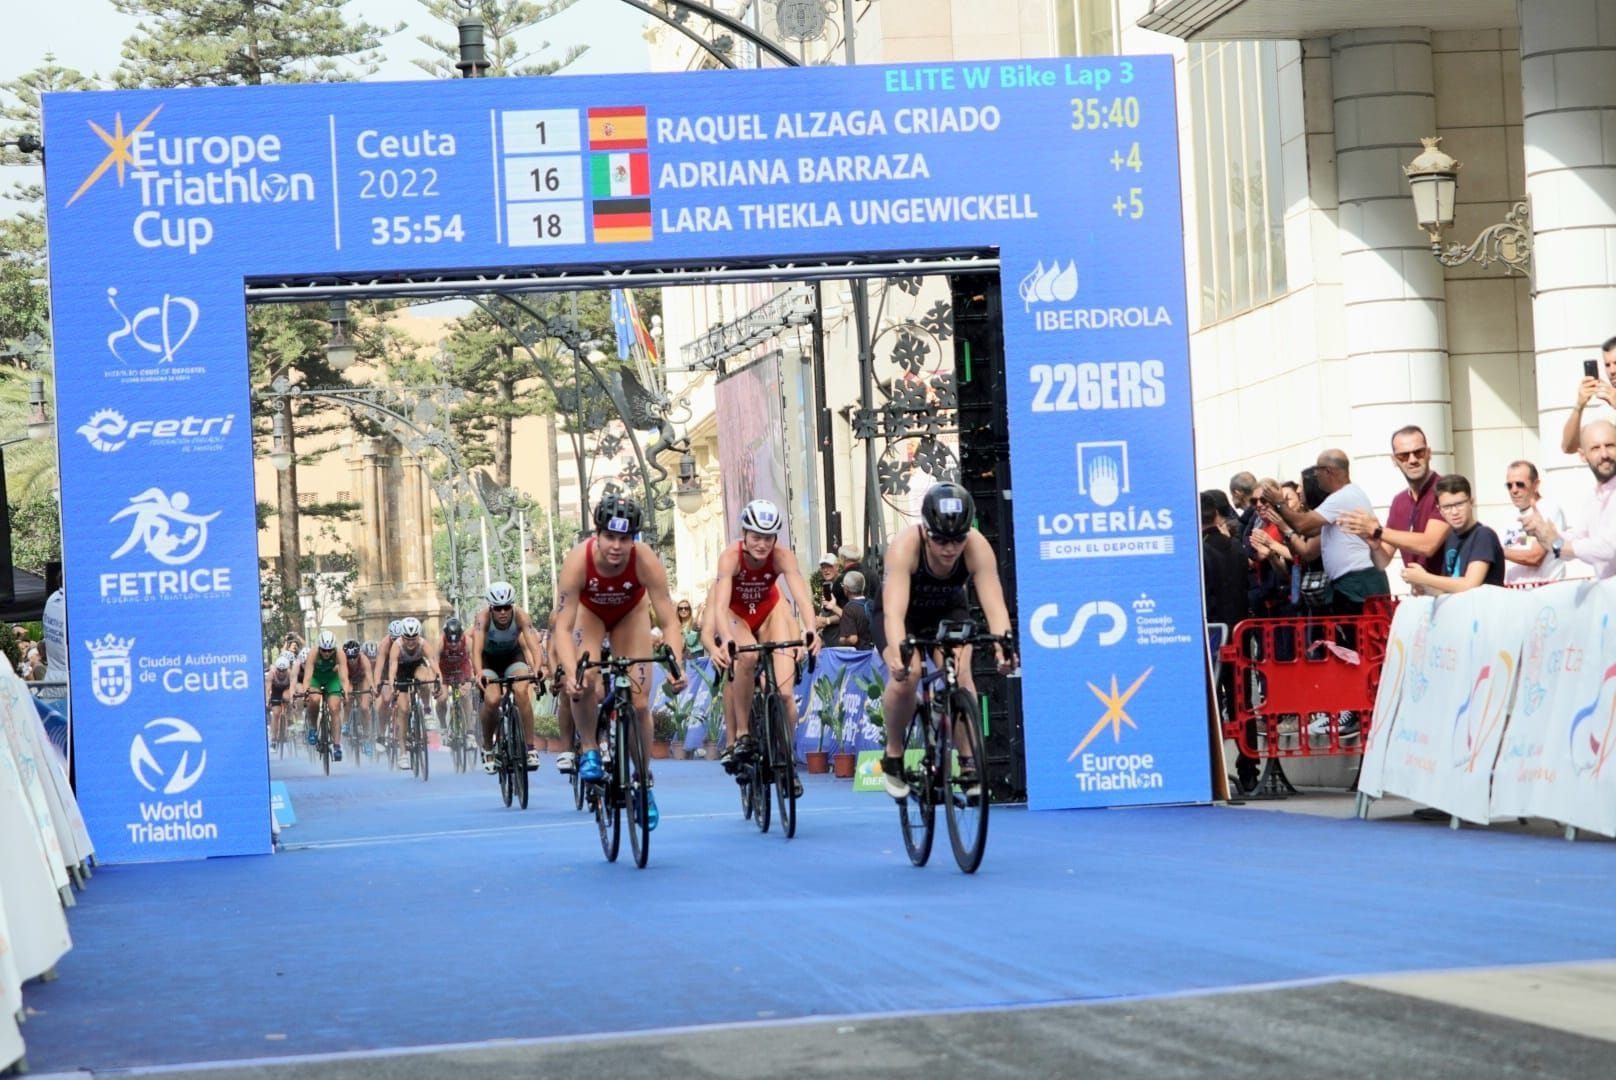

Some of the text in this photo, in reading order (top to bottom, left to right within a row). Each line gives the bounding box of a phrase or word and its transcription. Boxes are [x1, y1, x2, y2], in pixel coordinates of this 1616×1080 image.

[885, 62, 1135, 92] ELITE W Bike Lap 3
[535, 96, 1140, 145] 1 RAQUEL ALZAGA CRIADO 35:40
[131, 131, 280, 169] Europe
[356, 129, 456, 159] Ceuta
[530, 142, 1143, 192] 16 ADRIANA BARRAZA +4
[131, 168, 315, 207] Triathlon
[359, 168, 440, 199] 2022
[533, 187, 1144, 239] 18 LARA THEKLA UNGEWICKELL +5
[133, 211, 213, 254] Cup
[371, 214, 465, 246] 35:54
[1035, 306, 1173, 331] IBERDROLA
[1029, 360, 1166, 412] 226ERS
[127, 414, 236, 439] fetri
[1038, 506, 1174, 535] LOTERÍAS
[1056, 541, 1159, 554] CON EL DEPORTE
[100, 568, 231, 598] FETRICE
[1136, 615, 1173, 629] Consejo
[1137, 625, 1176, 636] Superior
[1137, 633, 1191, 645] de Deportes
[139, 653, 247, 668] Ciudad Autónoma
[139, 667, 249, 693] de Ceuta
[1082, 753, 1154, 772] Europe
[1075, 772, 1163, 792] Triathlon
[140, 800, 203, 821] World
[127, 819, 218, 843] Triathlon
